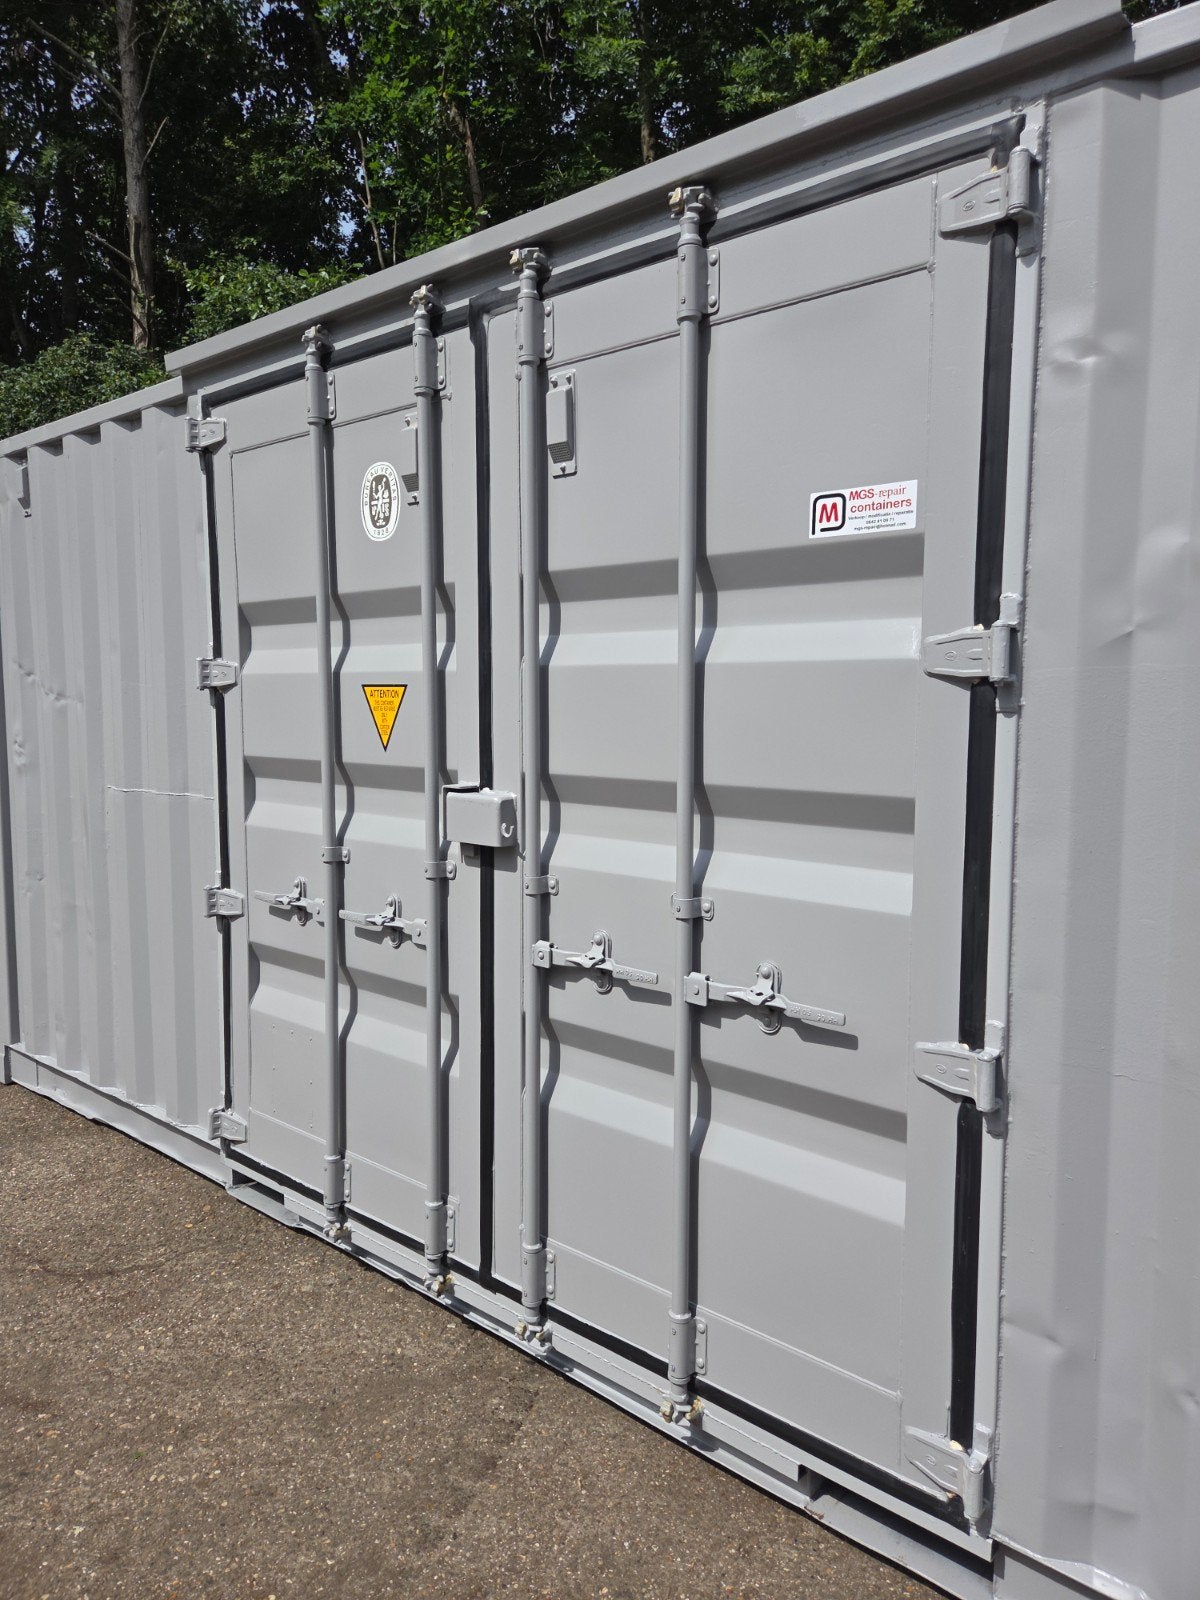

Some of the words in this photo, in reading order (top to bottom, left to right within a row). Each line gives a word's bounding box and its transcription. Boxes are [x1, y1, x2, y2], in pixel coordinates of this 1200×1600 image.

[819, 502, 839, 523] M
[850, 498, 912, 513] containers
[369, 689, 399, 698] ATTENTION
